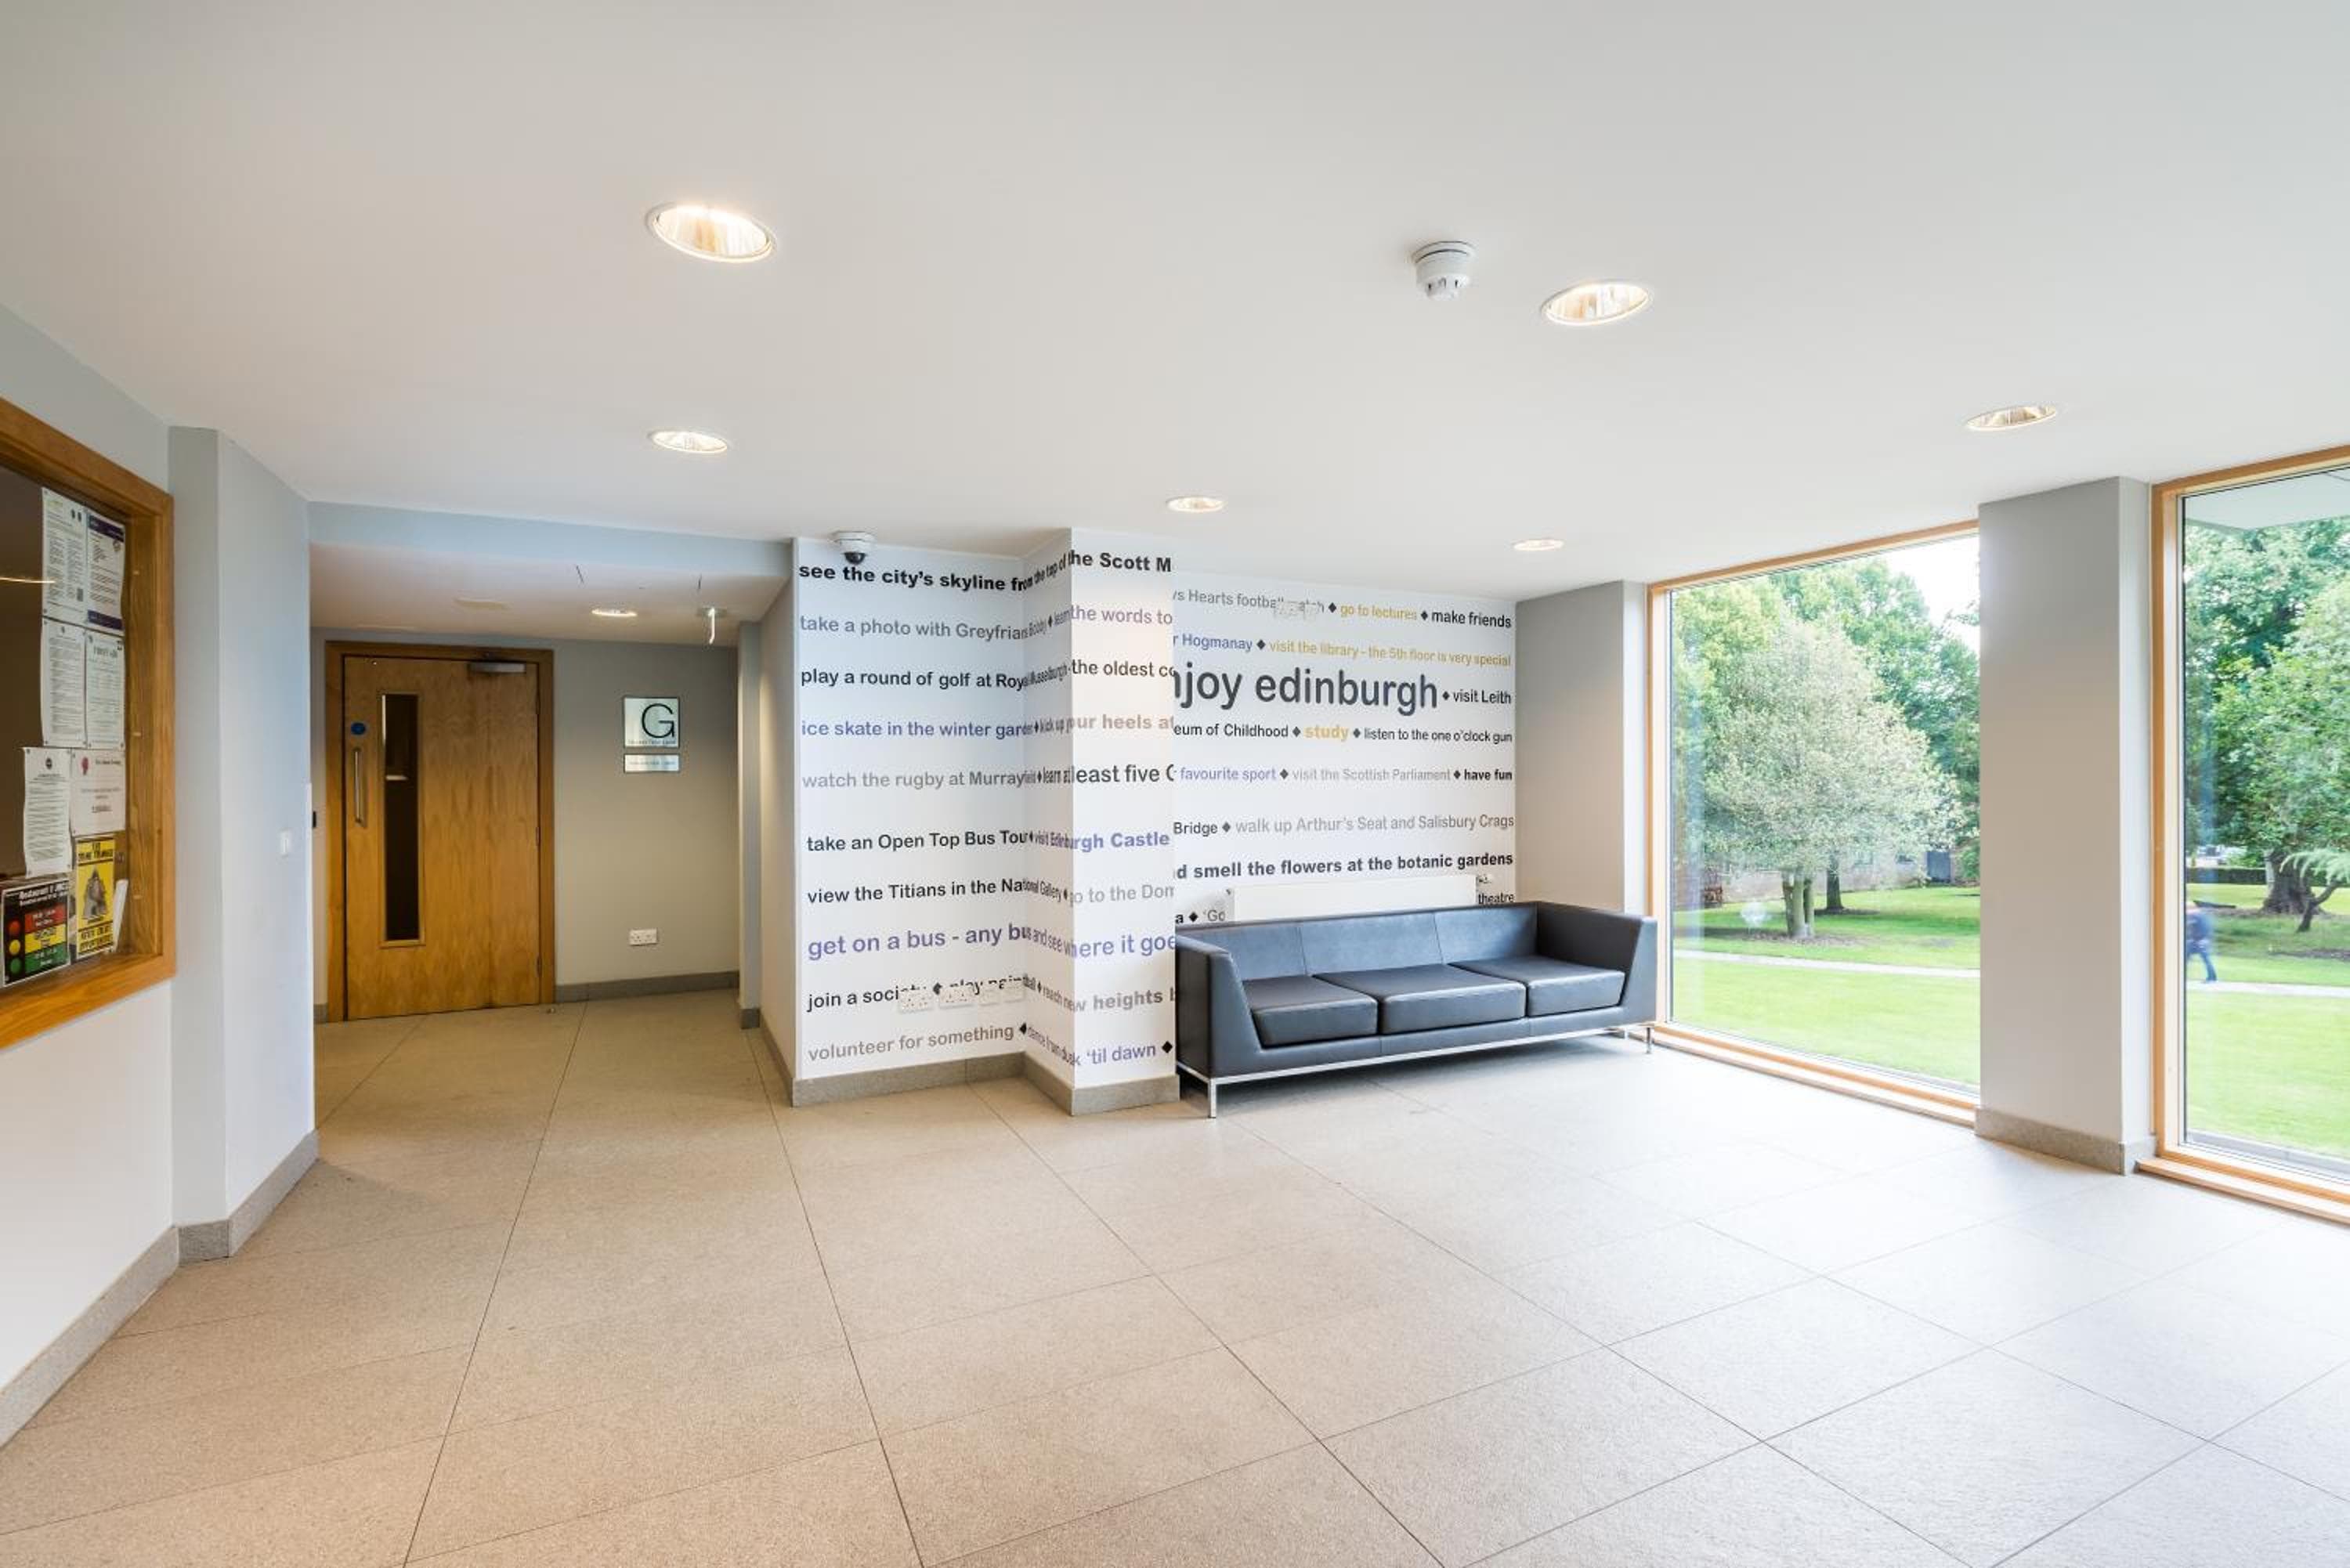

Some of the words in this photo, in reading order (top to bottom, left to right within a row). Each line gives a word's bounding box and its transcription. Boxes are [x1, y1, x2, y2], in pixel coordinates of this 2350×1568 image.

[799, 565, 835, 580] see
[843, 566, 875, 583] the
[882, 569, 933, 587] city's
[940, 574, 1005, 592] skyline
[1068, 550, 1093, 566] the
[1100, 552, 1150, 571] Scott
[1156, 558, 1171, 572] M
[801, 615, 838, 632] take
[844, 620, 854, 632] a
[862, 620, 910, 636] photo
[916, 622, 950, 637] with
[1071, 605, 1096, 620] the
[1102, 609, 1152, 624] words
[1156, 610, 1172, 625] to
[1188, 590, 1233, 606] Hearts
[1340, 604, 1354, 617] go
[1358, 603, 1368, 616] to
[1432, 610, 1466, 625] make
[1470, 612, 1512, 628] friends
[1182, 634, 1253, 652] Hogmanay
[1270, 640, 1295, 653] visit
[1298, 640, 1317, 653] the
[1320, 642, 1358, 659] library
[1368, 645, 1386, 658] the
[1390, 647, 1407, 659] 5th
[1410, 649, 1434, 661] floor
[1437, 652, 1446, 662] is
[1449, 653, 1470, 667] very
[1474, 653, 1511, 667] special
[801, 667, 838, 687] play
[844, 673, 854, 685] a
[861, 670, 910, 686] round
[916, 672, 933, 686] of
[939, 672, 970, 690] golf
[977, 674, 991, 688] at
[1072, 659, 1097, 674] the
[1103, 661, 1154, 677] oldest
[1256, 667, 1437, 716] edinburgh
[1454, 688, 1479, 703] visit
[1481, 689, 1511, 704] Leith
[642, 703, 674, 739] G
[802, 721, 829, 736] ice
[834, 721, 881, 736] skate
[888, 721, 902, 735] in
[907, 721, 934, 736] the
[939, 721, 991, 737] winter
[1102, 714, 1152, 729] heels
[1173, 724, 1202, 736] eum
[1206, 723, 1219, 736] of
[1224, 723, 1289, 737] Childhood
[1305, 725, 1348, 742] study
[1364, 728, 1394, 740] listen
[1398, 729, 1408, 740] to
[1412, 729, 1428, 741] the
[1432, 732, 1451, 741] one
[1454, 730, 1491, 742] o'clock
[1493, 733, 1512, 744] gun
[803, 773, 856, 788] watch
[862, 773, 890, 787] the
[895, 772, 942, 790] rugby
[949, 773, 965, 786] at
[1126, 764, 1160, 783] five
[1180, 766, 1238, 781] favourite
[1242, 768, 1276, 782] sport
[1293, 768, 1318, 781] visit
[1321, 768, 1339, 780] the
[1343, 768, 1390, 781] Scottish
[1392, 768, 1450, 781] Parliament
[1464, 770, 1491, 781] have
[1494, 769, 1512, 780] fun
[1173, 821, 1217, 836] Bridge
[1235, 817, 1270, 833] walk
[1274, 820, 1292, 835] up
[1296, 815, 1354, 832] Arthur's
[1358, 815, 1387, 830] Seat
[1391, 815, 1414, 830] and
[1419, 814, 1476, 830] Salisbury
[1480, 814, 1514, 829] Crags
[808, 836, 845, 852] take
[851, 836, 873, 851] an
[879, 833, 924, 853] Open
[929, 833, 960, 851] Top
[965, 831, 995, 846] Bus
[1111, 832, 1170, 847] Castle
[1194, 861, 1242, 879] smell
[1248, 860, 1275, 876] the
[1281, 858, 1342, 874] flowers
[1347, 857, 1362, 872] at
[1368, 855, 1392, 871] the
[1397, 853, 1452, 869] botanic
[1458, 851, 1513, 869] gardens
[808, 889, 849, 904] view
[855, 885, 883, 901] the
[888, 882, 945, 899] Titians
[951, 881, 965, 895] in
[971, 879, 996, 894] the
[1089, 886, 1104, 904] to
[1110, 883, 1137, 901] the
[1478, 893, 1515, 904] theatre
[808, 934, 846, 961] get
[853, 935, 880, 953] on
[888, 934, 900, 951] a
[907, 929, 945, 948] bus
[966, 926, 1002, 947] any
[1008, 923, 1031, 941] bus
[1121, 934, 1135, 955] it
[807, 988, 841, 1013] join
[847, 990, 857, 1006] a
[863, 986, 927, 1003] soci
[1093, 988, 1162, 1010] heights
[808, 1037, 891, 1062] volunteer
[898, 1033, 924, 1050] for
[928, 1024, 1014, 1049] something
[1112, 1045, 1155, 1062] dawn
